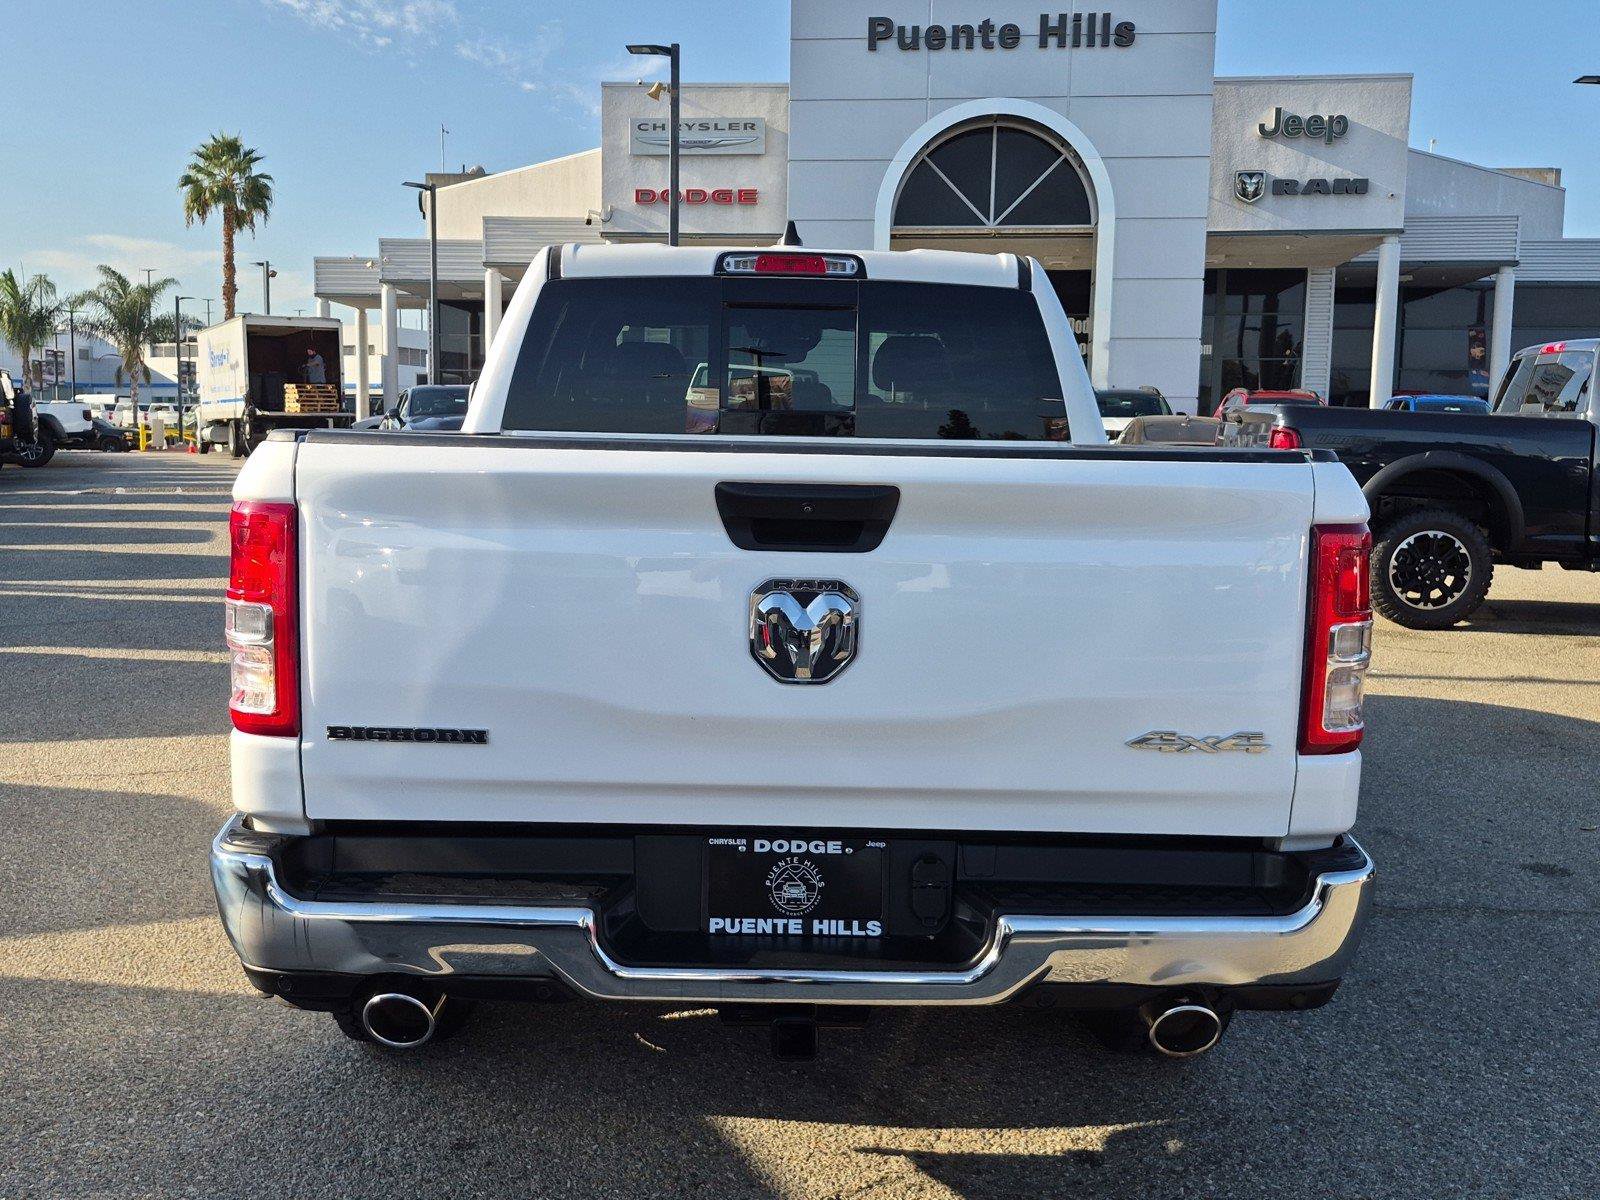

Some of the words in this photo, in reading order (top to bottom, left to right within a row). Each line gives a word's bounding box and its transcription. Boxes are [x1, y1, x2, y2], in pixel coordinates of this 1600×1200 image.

[868, 16, 1021, 51] Puente
[1039, 12, 1136, 48] Hills
[637, 122, 757, 131] CHYSLER
[1258, 107, 1349, 145] Jeep
[1272, 178, 1369, 196] RAM
[634, 188, 759, 205] DODGE
[772, 580, 839, 591] RAM
[327, 725, 489, 744] BIGHORN
[708, 838, 747, 846] CHRYSLER
[753, 839, 842, 854] DODGE
[865, 840, 887, 849] Jeep
[765, 856, 799, 886] PUENTE
[803, 859, 826, 888] HILLS
[709, 917, 803, 934] PUENTE
[812, 919, 882, 937] HILLS
